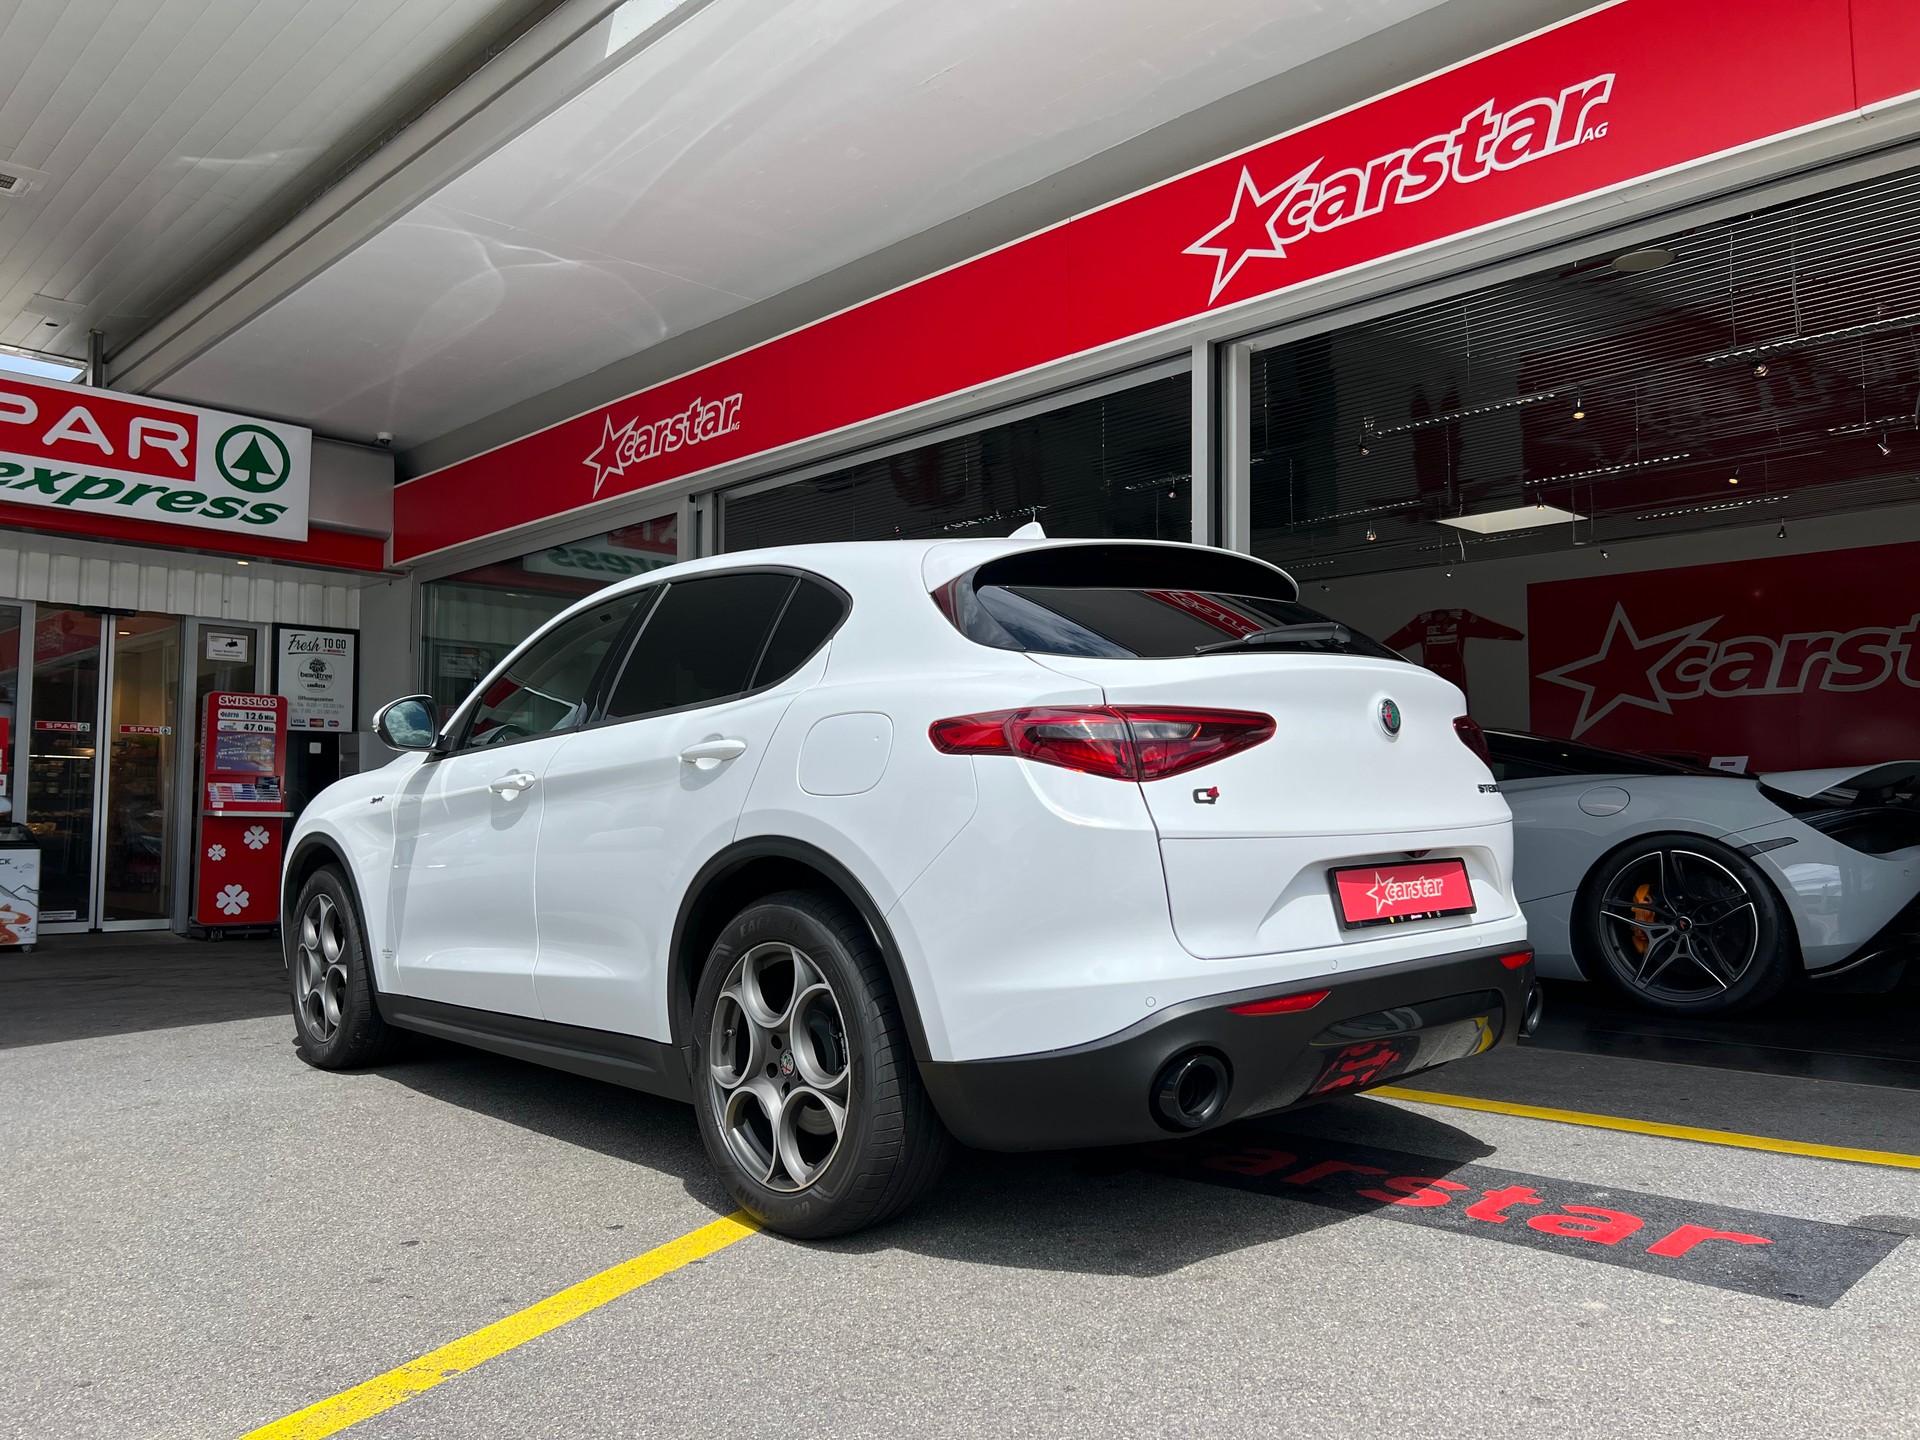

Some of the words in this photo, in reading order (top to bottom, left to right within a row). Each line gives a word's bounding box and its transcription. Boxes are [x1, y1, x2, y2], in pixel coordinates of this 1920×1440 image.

[1267, 72, 1616, 245] carstar
[1581, 121, 1609, 143] AG
[616, 393, 743, 467] carstar
[730, 421, 741, 433] AG
[0, 461, 289, 525] express
[287, 633, 322, 652] Fresh
[323, 637, 334, 649] TO
[335, 638, 347, 650] GO
[219, 696, 277, 707] SWISSLOS
[45, 722, 79, 730] SPAR
[1192, 786, 1220, 805] Q4
[1386, 876, 1443, 901] carstar
